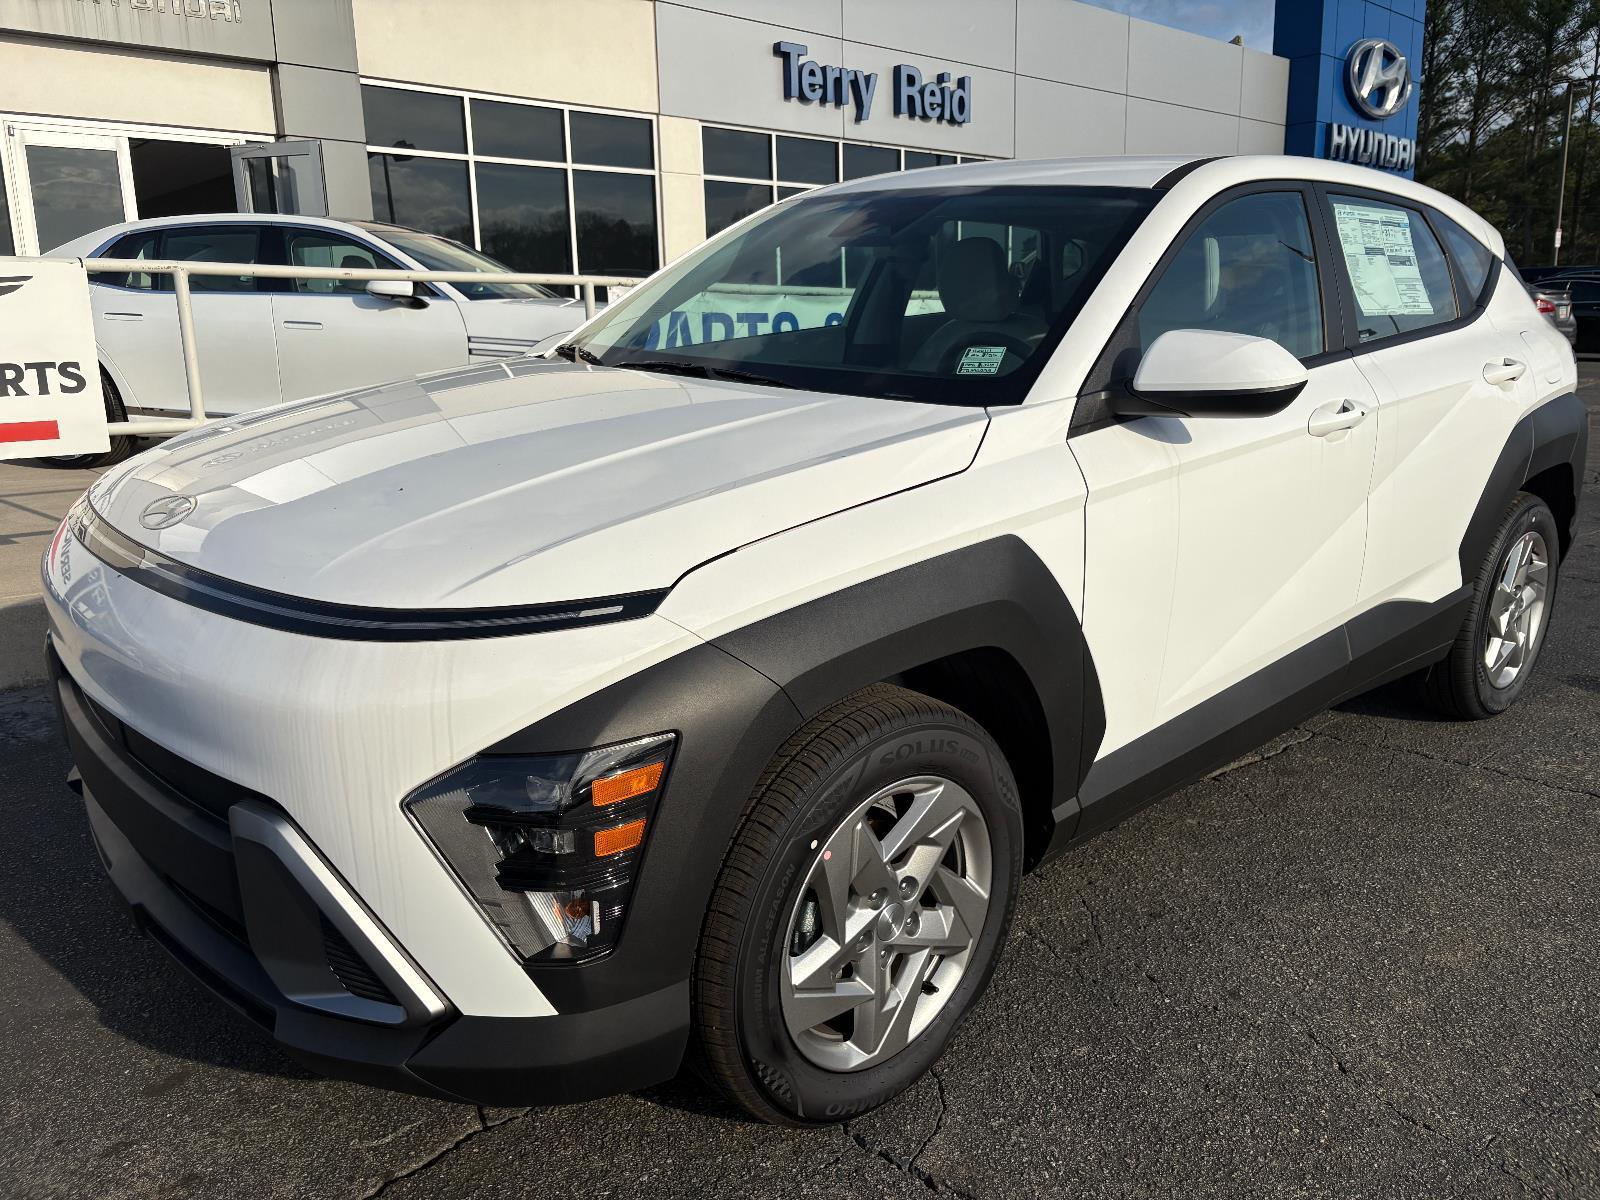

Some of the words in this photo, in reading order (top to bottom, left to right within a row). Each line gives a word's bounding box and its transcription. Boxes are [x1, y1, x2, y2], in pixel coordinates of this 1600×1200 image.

[773, 41, 878, 122] Terry
[893, 64, 971, 124] Reid
[1330, 122, 1417, 170] HYUNDAI
[880, 739, 959, 768] SOLUS
[758, 863, 797, 965] ALL-SEASON
